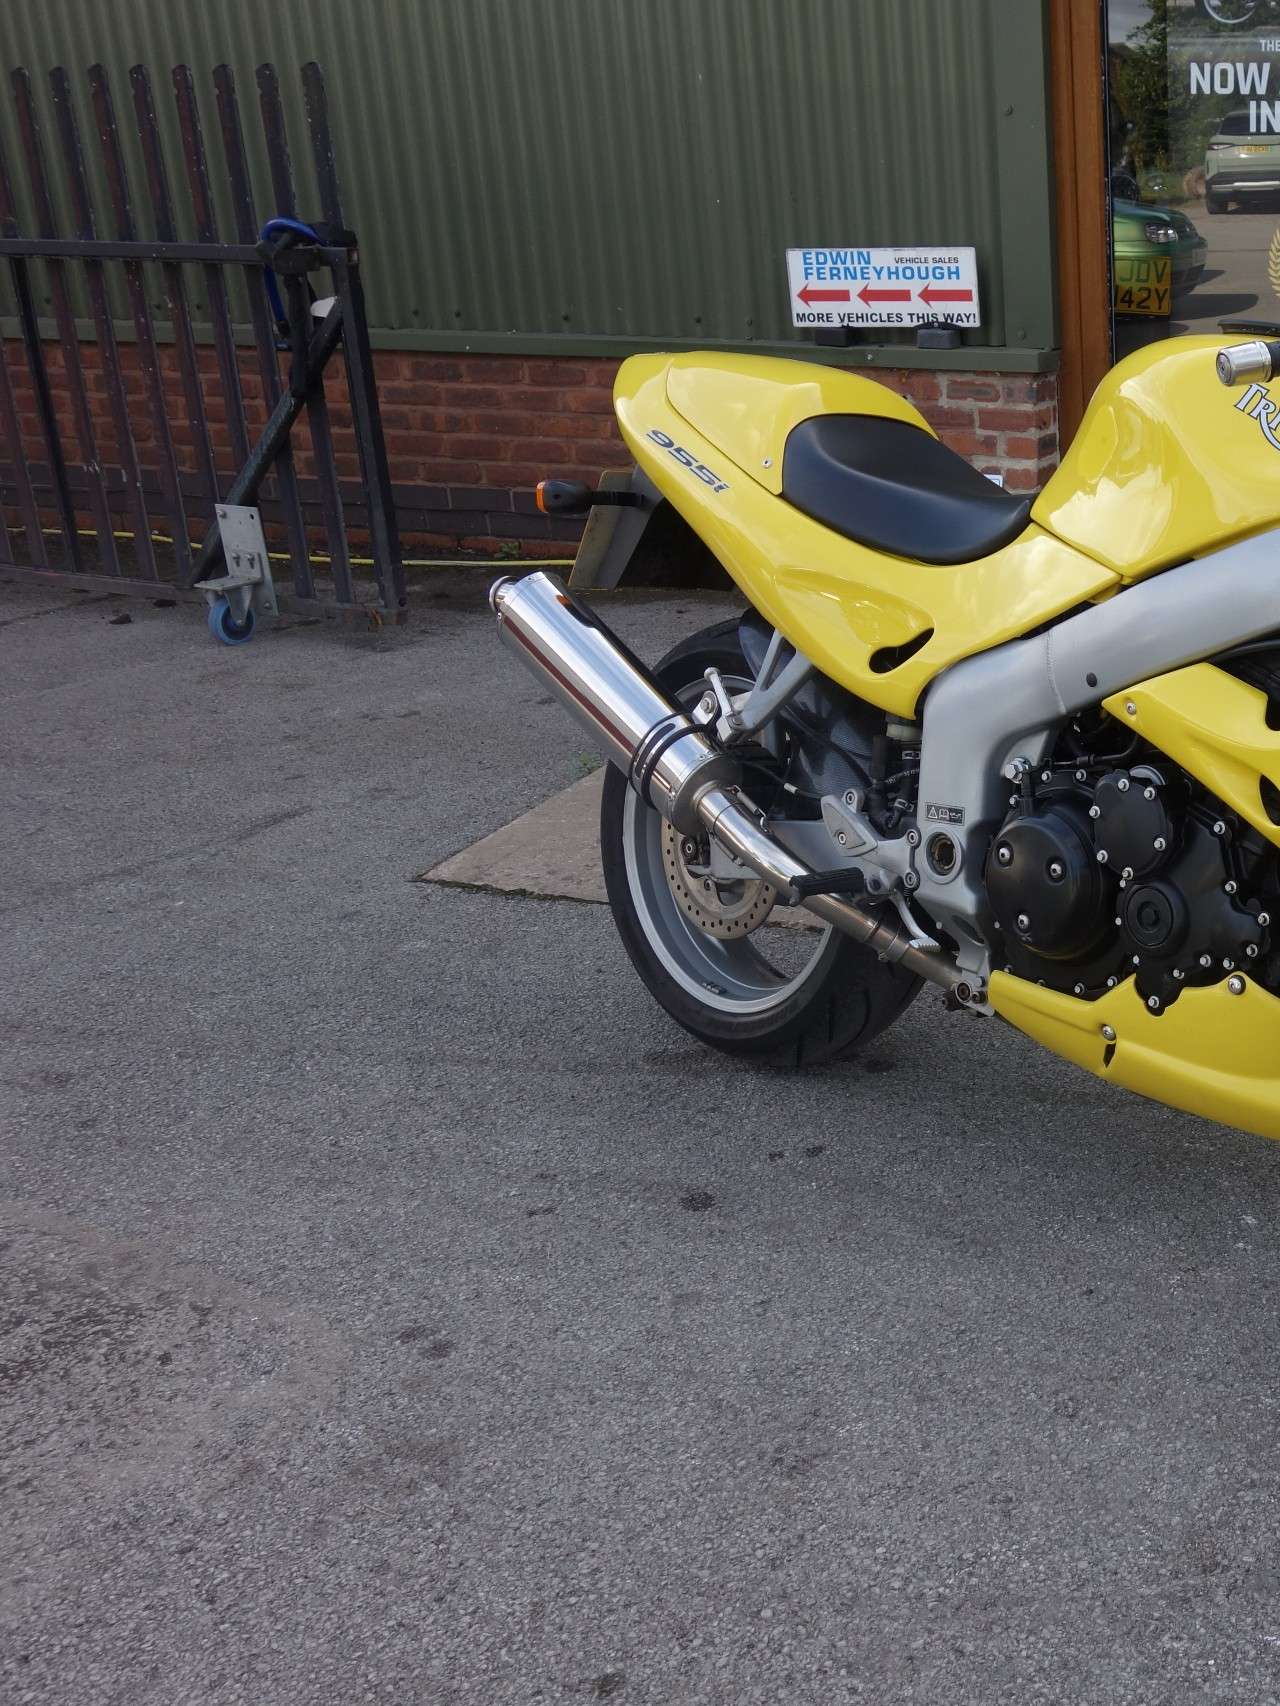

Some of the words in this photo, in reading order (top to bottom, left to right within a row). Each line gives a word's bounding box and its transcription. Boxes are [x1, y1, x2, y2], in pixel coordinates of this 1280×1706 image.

[1260, 40, 1280, 52] THE
[1189, 62, 1271, 95] NOW
[802, 250, 872, 265] EDWIN
[894, 256, 929, 264] VEHICLE
[931, 256, 959, 264] SALES
[803, 266, 961, 281] FERNEYHOUGH
[796, 313, 833, 323] MORE
[838, 313, 903, 323] VEHICLES
[907, 313, 942, 323] THIS
[943, 313, 977, 323] WAY!
[646, 429, 730, 493] 955i
